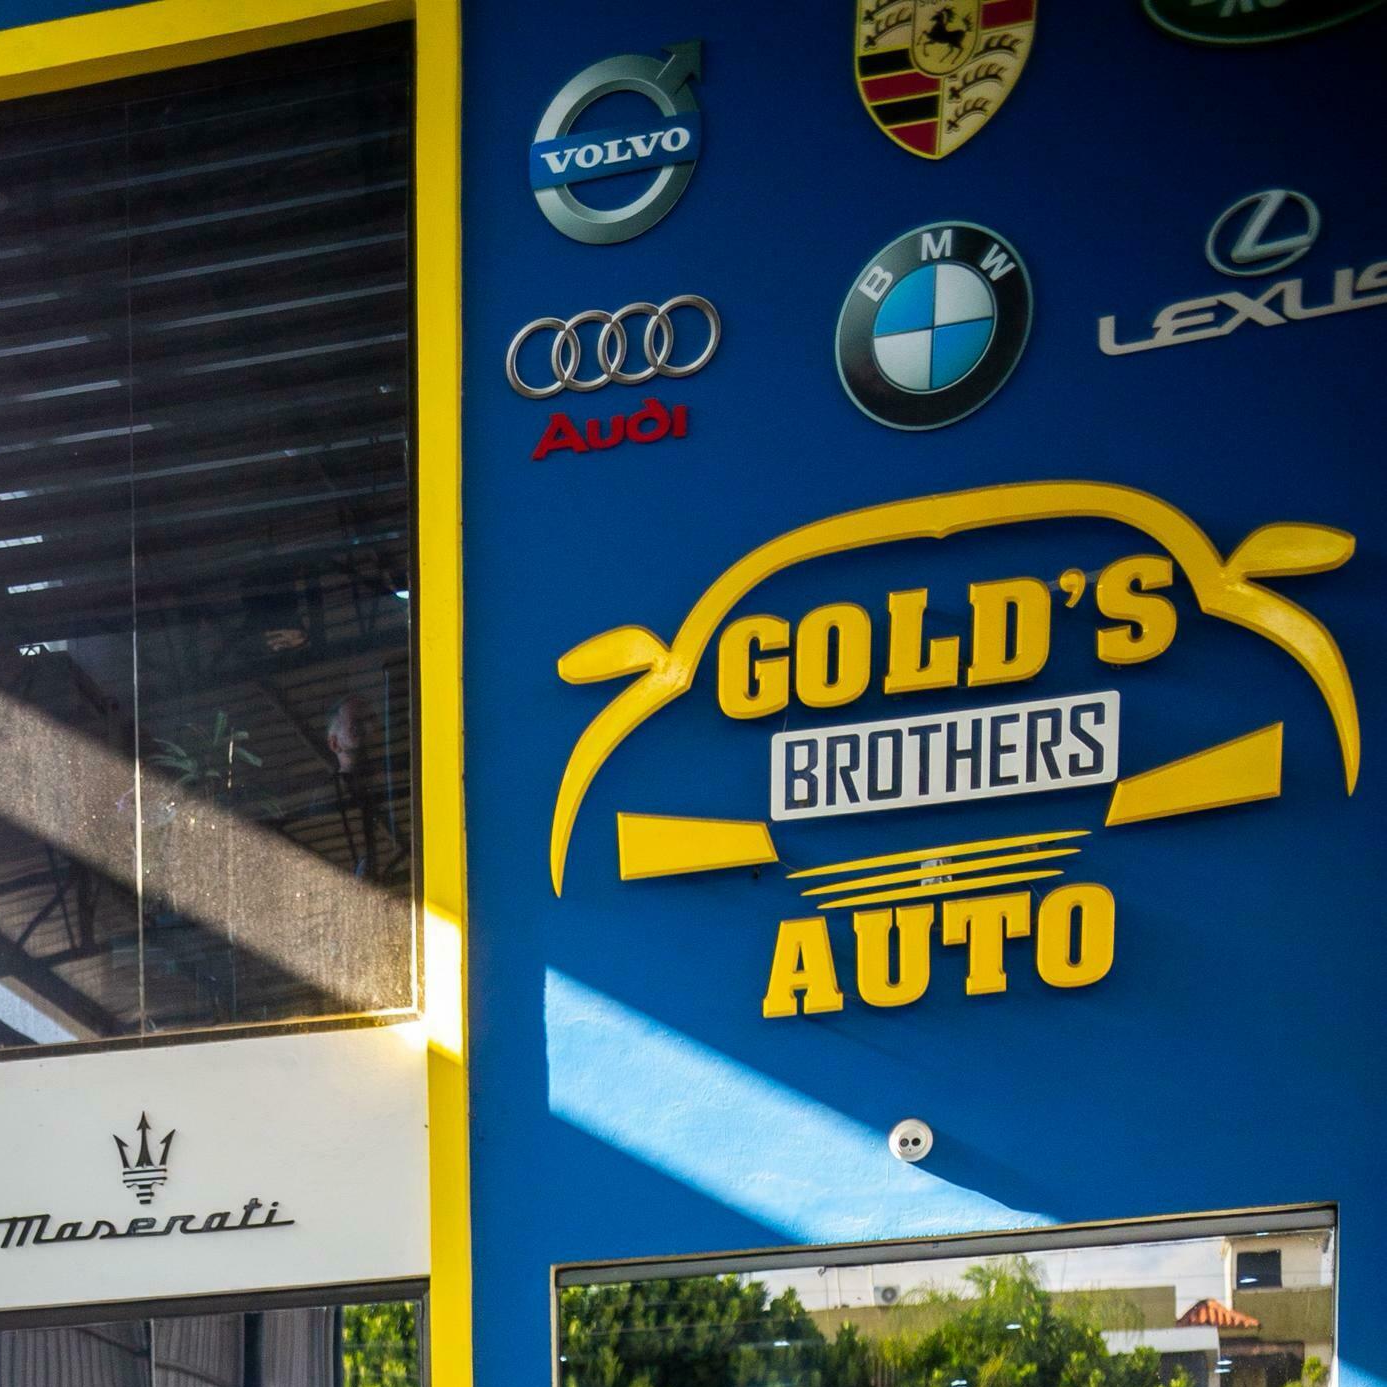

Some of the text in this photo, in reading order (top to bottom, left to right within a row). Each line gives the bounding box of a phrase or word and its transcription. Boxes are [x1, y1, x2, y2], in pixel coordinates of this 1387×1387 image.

[539, 126, 691, 174] VOLVO
[858, 228, 1015, 303] BMW
[531, 398, 689, 460] Audi
[716, 555, 1179, 721] GOLD'S
[783, 700, 1108, 813] BROTHERS
[762, 882, 1117, 1020] AUTO
